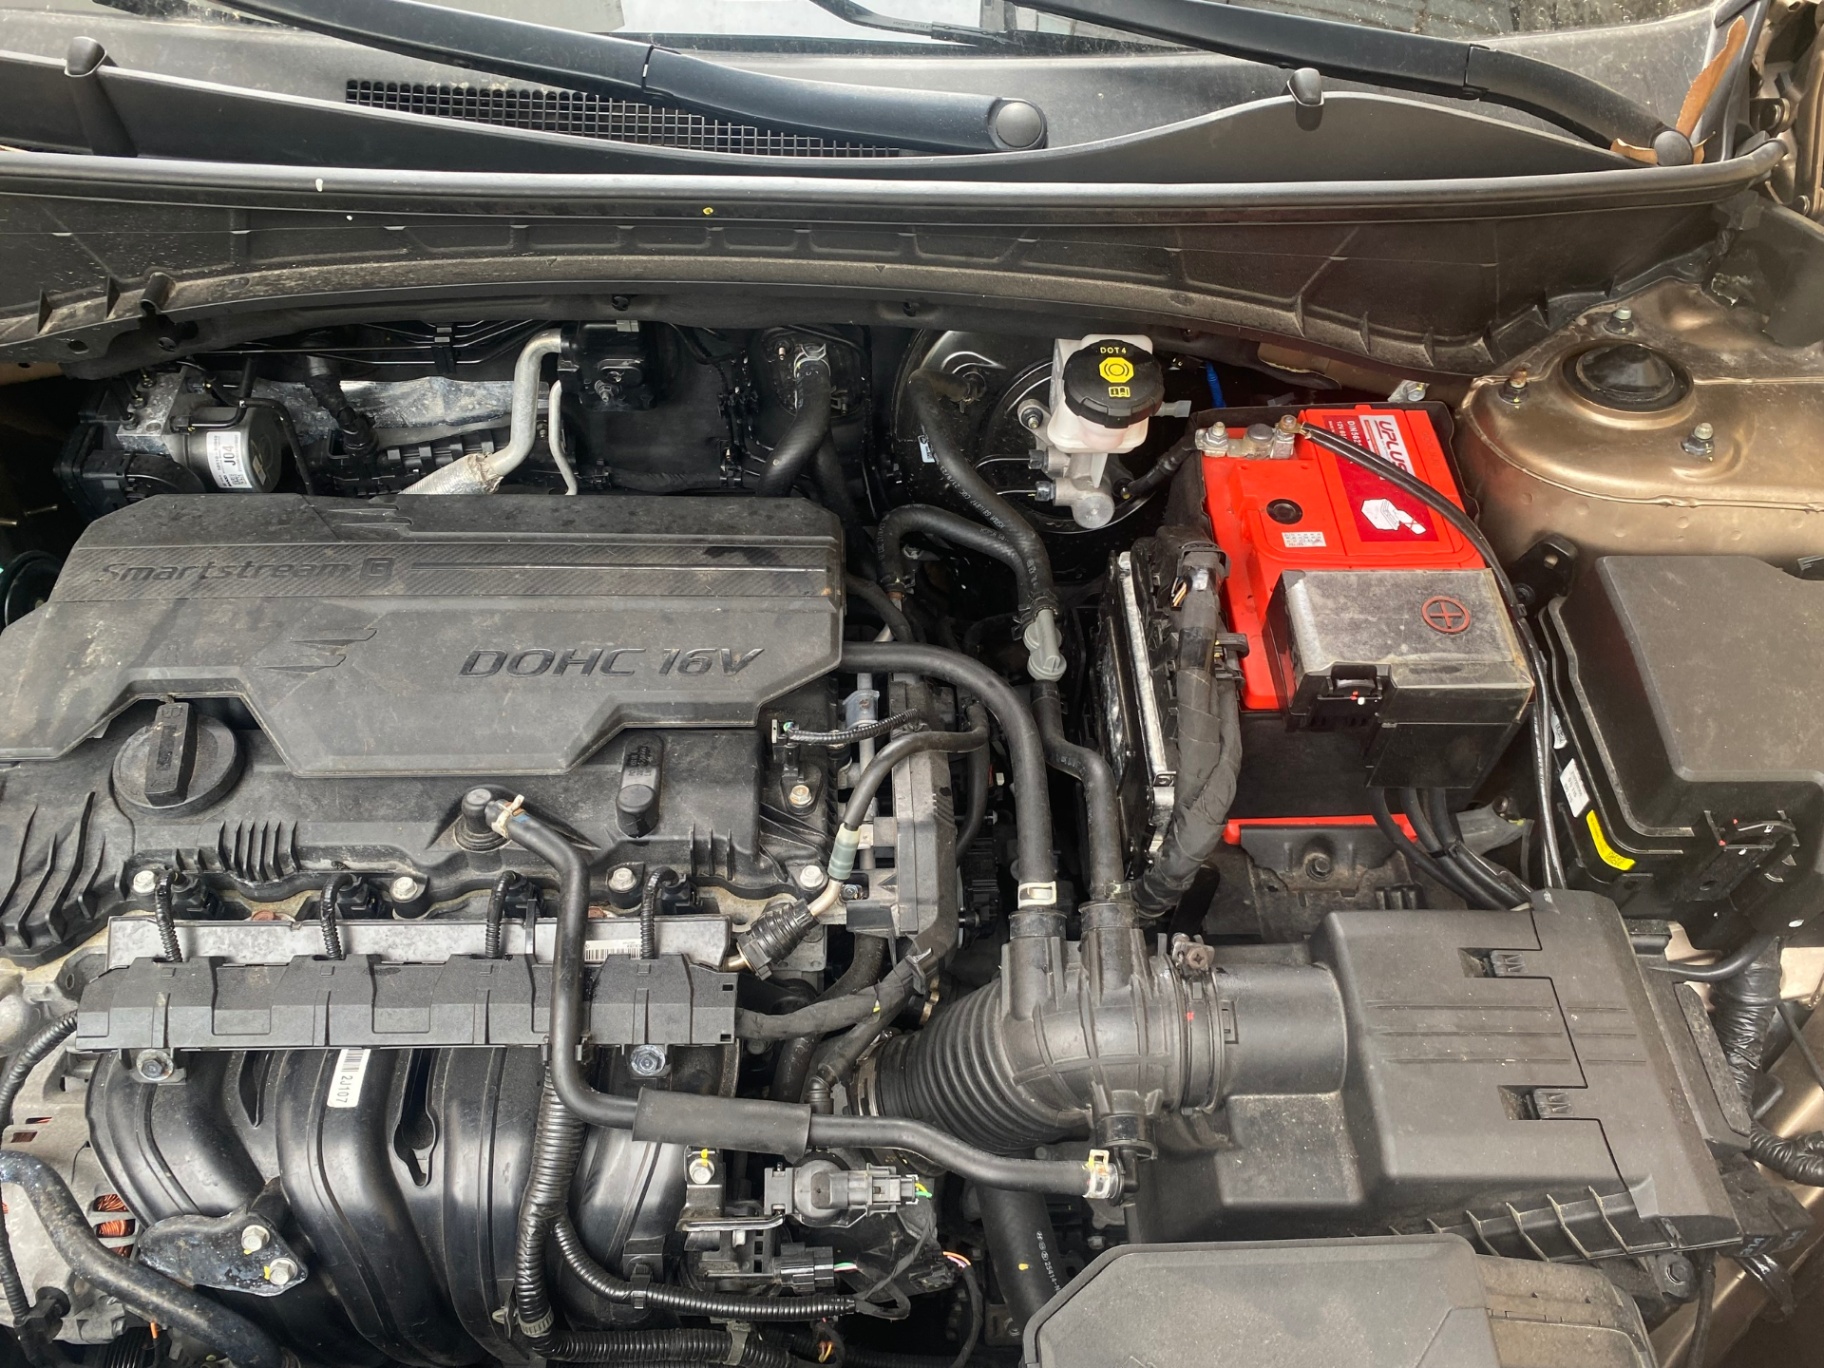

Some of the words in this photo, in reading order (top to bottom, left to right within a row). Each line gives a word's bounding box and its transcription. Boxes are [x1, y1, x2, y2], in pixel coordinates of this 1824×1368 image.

[1100, 346, 1119, 354] DOT
[222, 445, 236, 466] J04
[102, 561, 351, 581] Smartstream
[459, 648, 647, 678] DOHC
[658, 648, 765, 676] 16V
[335, 1075, 354, 1103] 2J107
